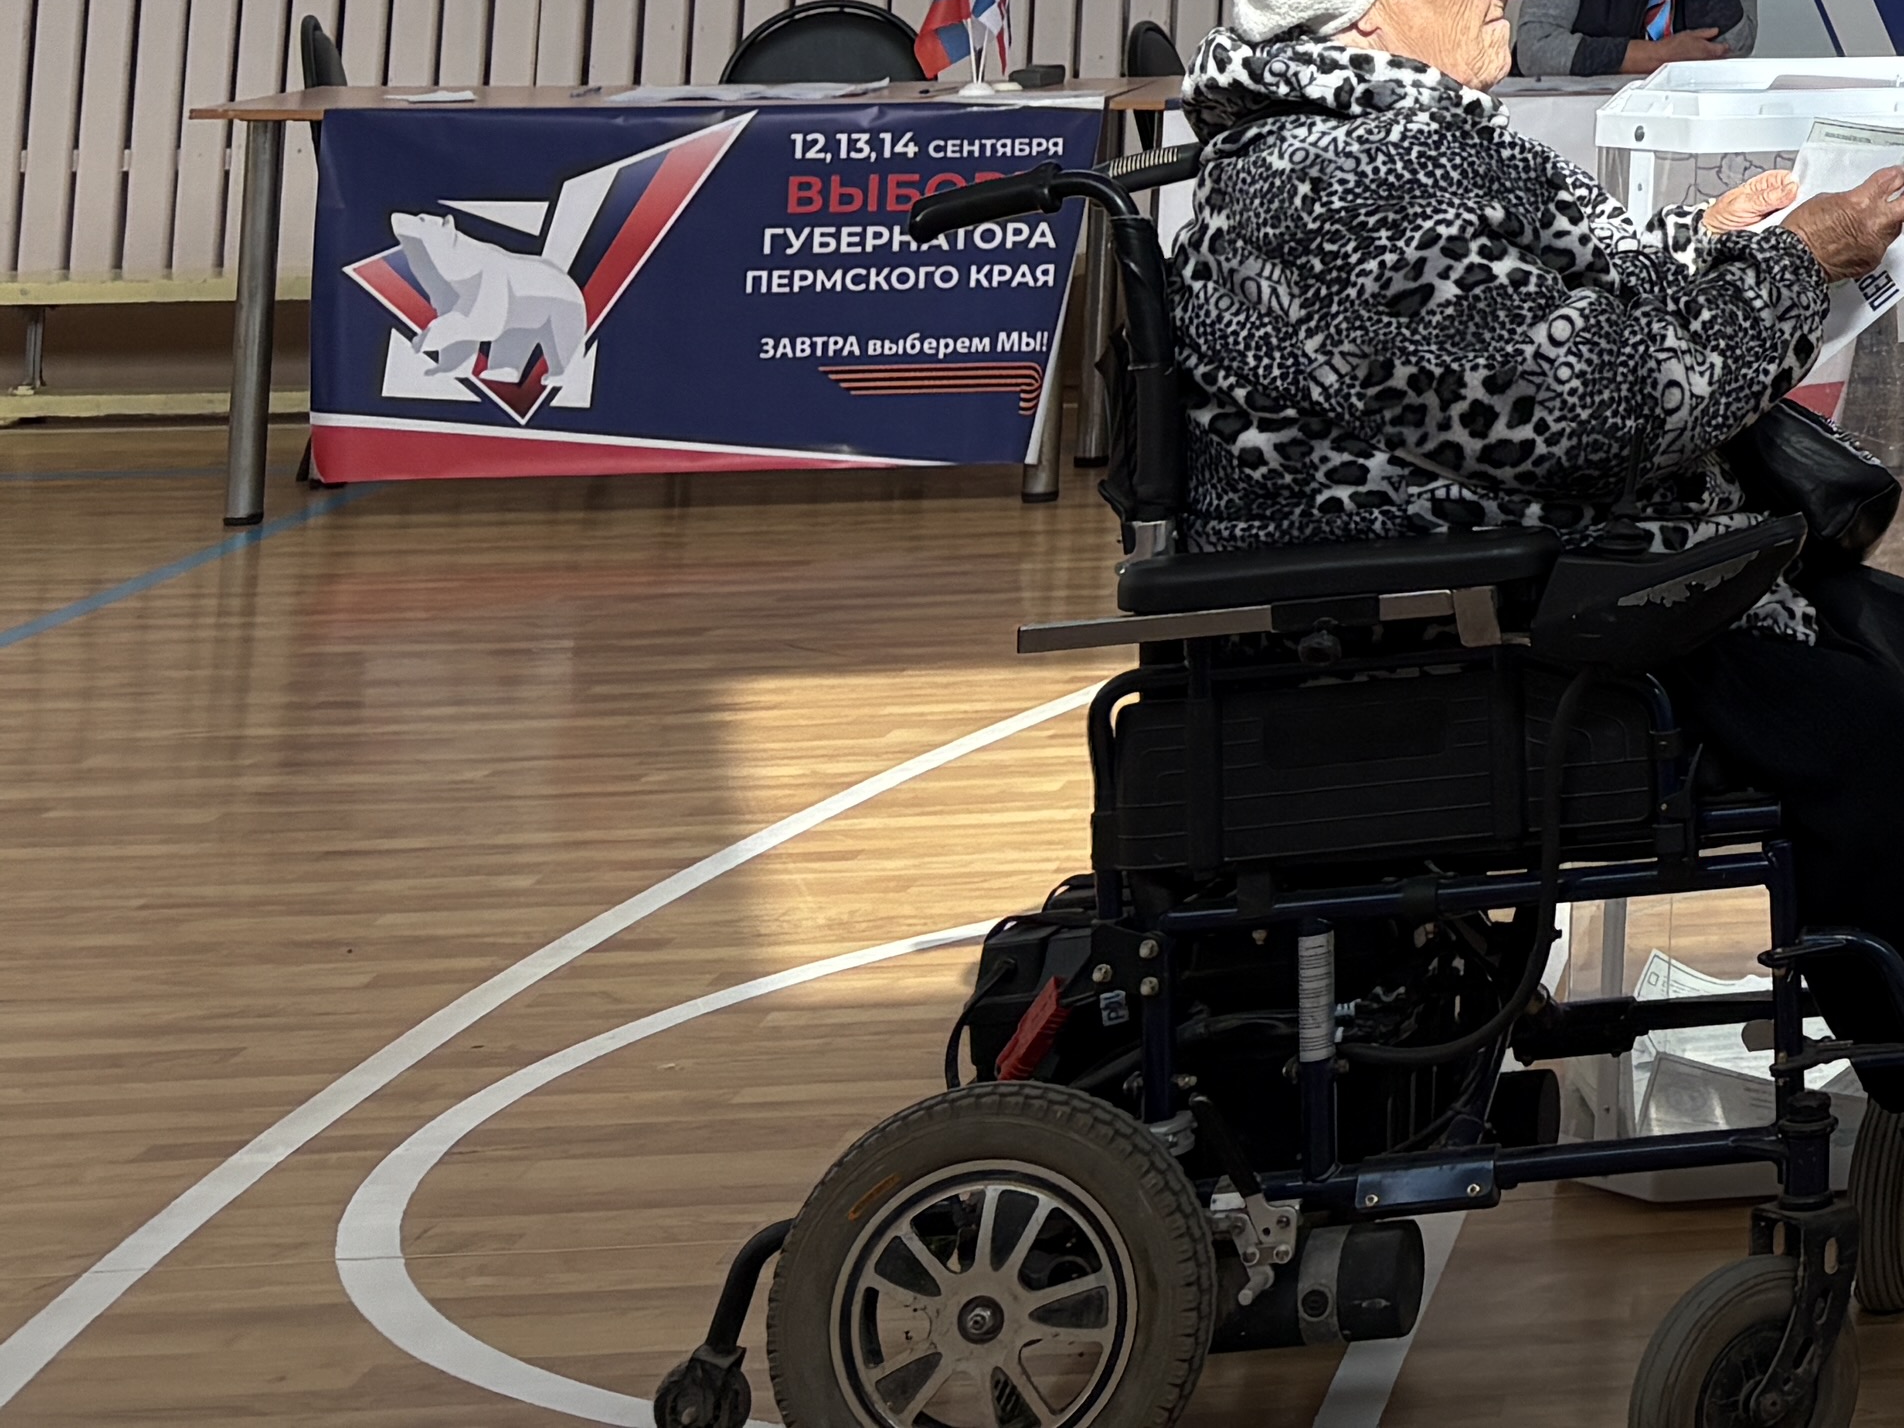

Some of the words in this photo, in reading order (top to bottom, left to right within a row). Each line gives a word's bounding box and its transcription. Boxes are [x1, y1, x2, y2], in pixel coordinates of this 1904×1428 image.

[790, 131, 919, 164] 12,13,14
[928, 137, 1065, 158] СЕНТЯБРЯ
[786, 171, 1025, 214] ВЫБ
[745, 264, 960, 294] ПЕРМСКОГО
[969, 263, 1056, 288] КРАЯ
[759, 335, 862, 359] ЗАВТРА
[867, 333, 991, 359] выберем
[995, 330, 1049, 353] МЫ!
